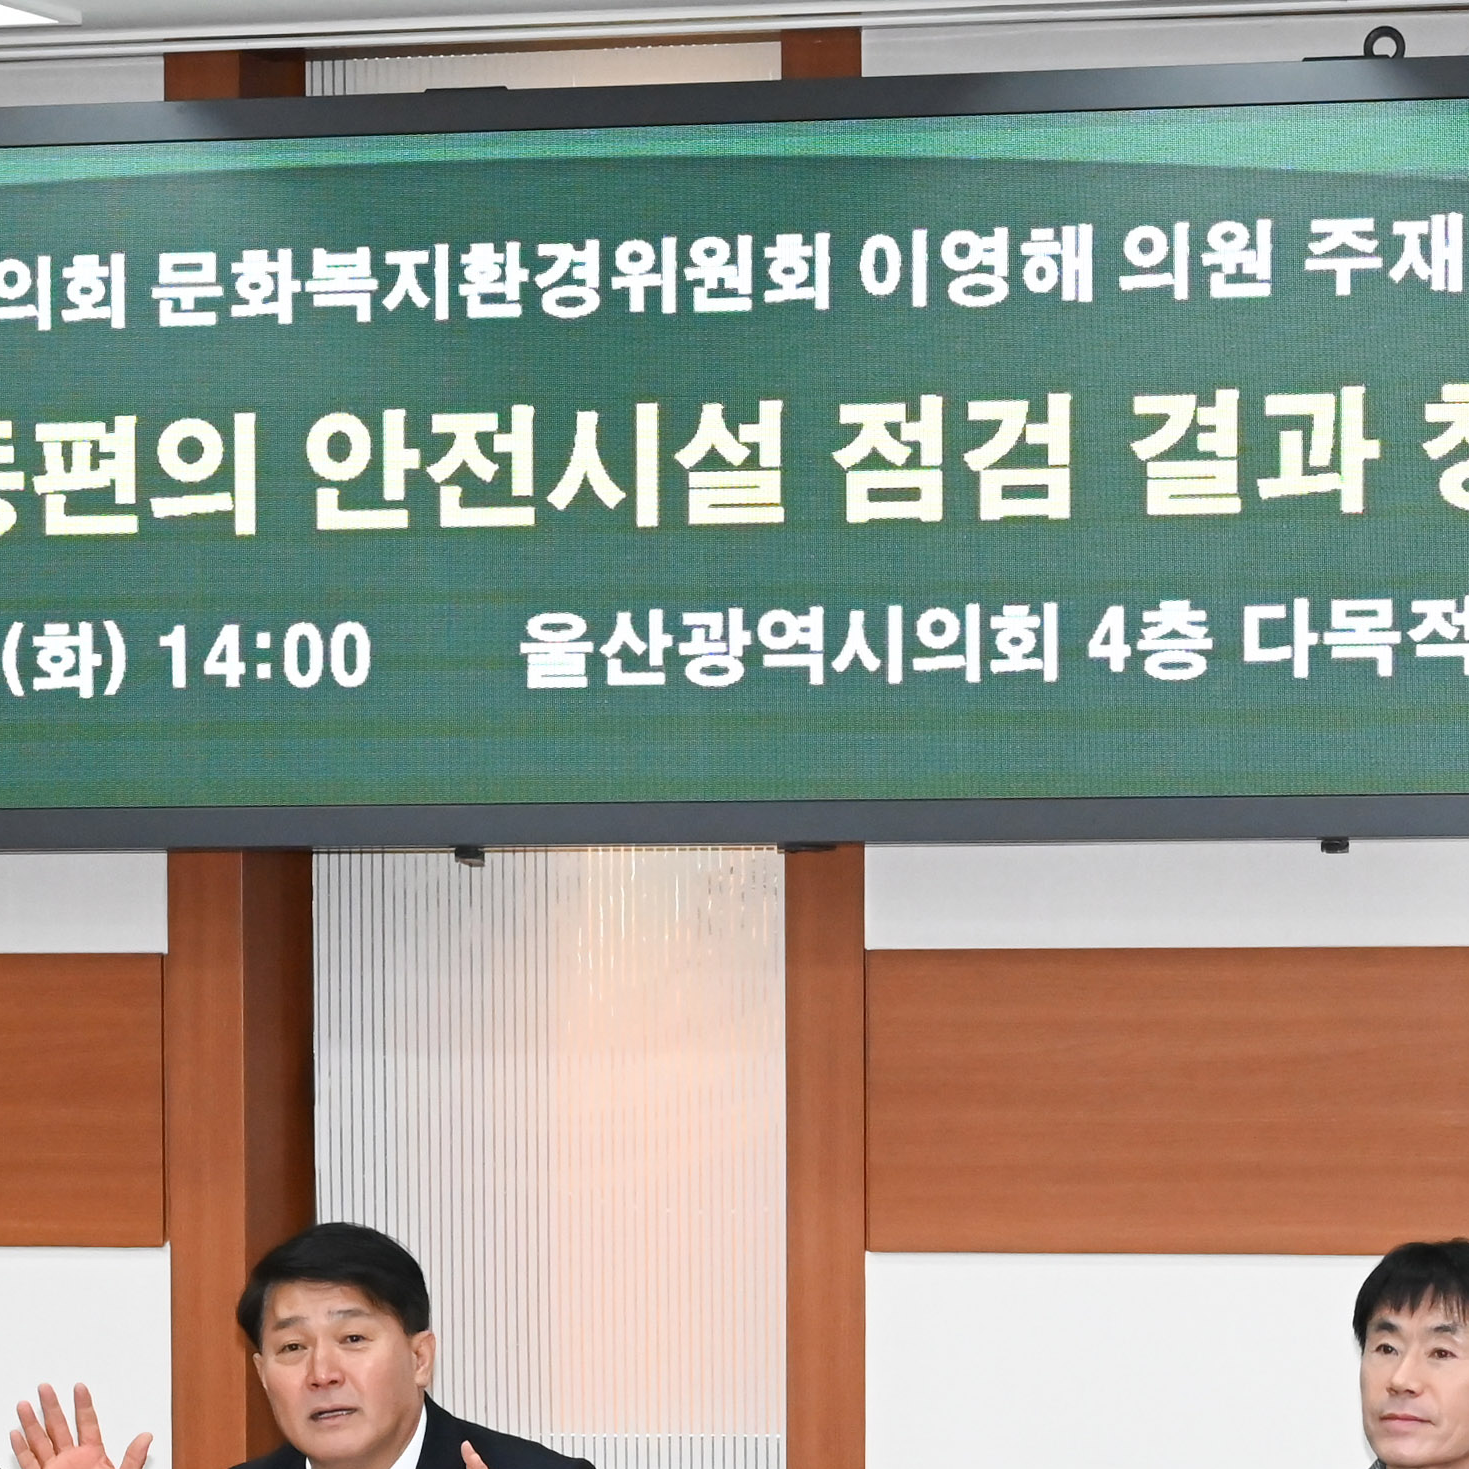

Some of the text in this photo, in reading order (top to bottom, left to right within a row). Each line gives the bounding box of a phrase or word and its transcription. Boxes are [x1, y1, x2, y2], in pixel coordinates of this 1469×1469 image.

[151, 232, 831, 327] 문화복지환경위원회
[859, 223, 1093, 307] 이영해
[1119, 218, 1272, 300] 의원
[1304, 211, 1463, 296] 주재
[306, 400, 786, 534] 안전시설
[832, 392, 1072, 523] 점검
[1131, 384, 1381, 515] 결과
[158, 620, 372, 689] 14:00
[519, 602, 1060, 689] 울산광역시의회
[1087, 599, 1214, 680] 4층
